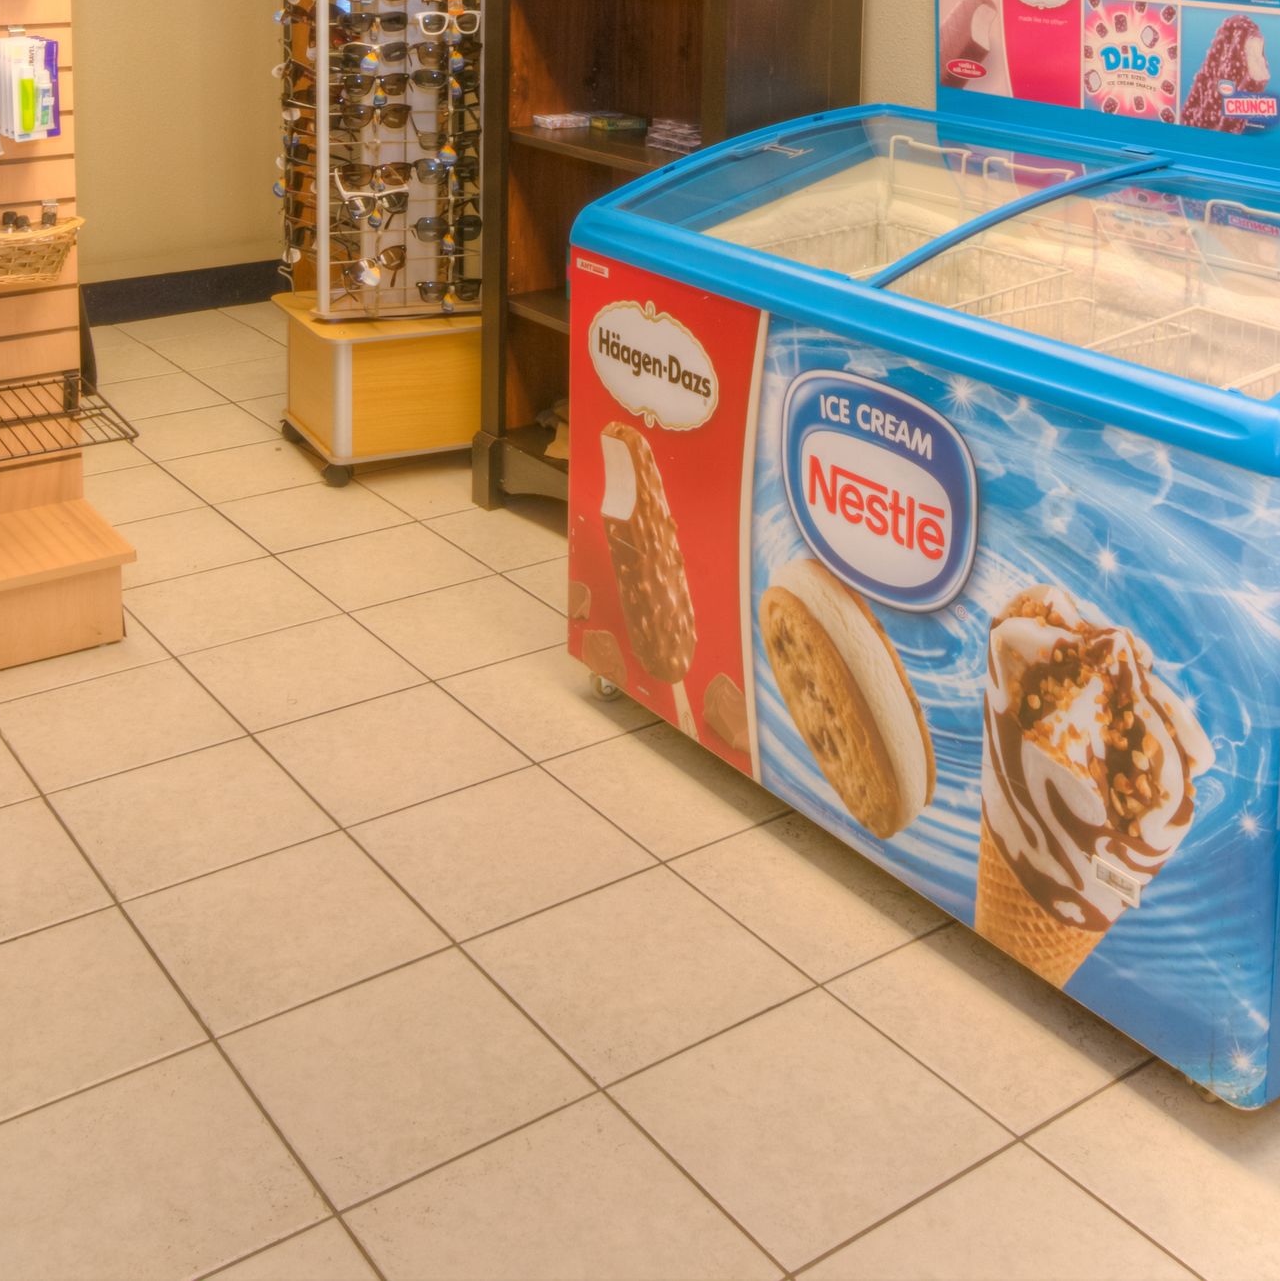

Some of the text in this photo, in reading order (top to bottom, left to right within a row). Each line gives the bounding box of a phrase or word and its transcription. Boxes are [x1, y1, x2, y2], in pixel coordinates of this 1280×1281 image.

[1100, 45, 1162, 77] Dibs
[1116, 80, 1134, 88] CREAM
[1135, 82, 1157, 91] SNACKS
[1225, 98, 1277, 115] CRUNCH
[819, 394, 933, 461] ICE CREAM
